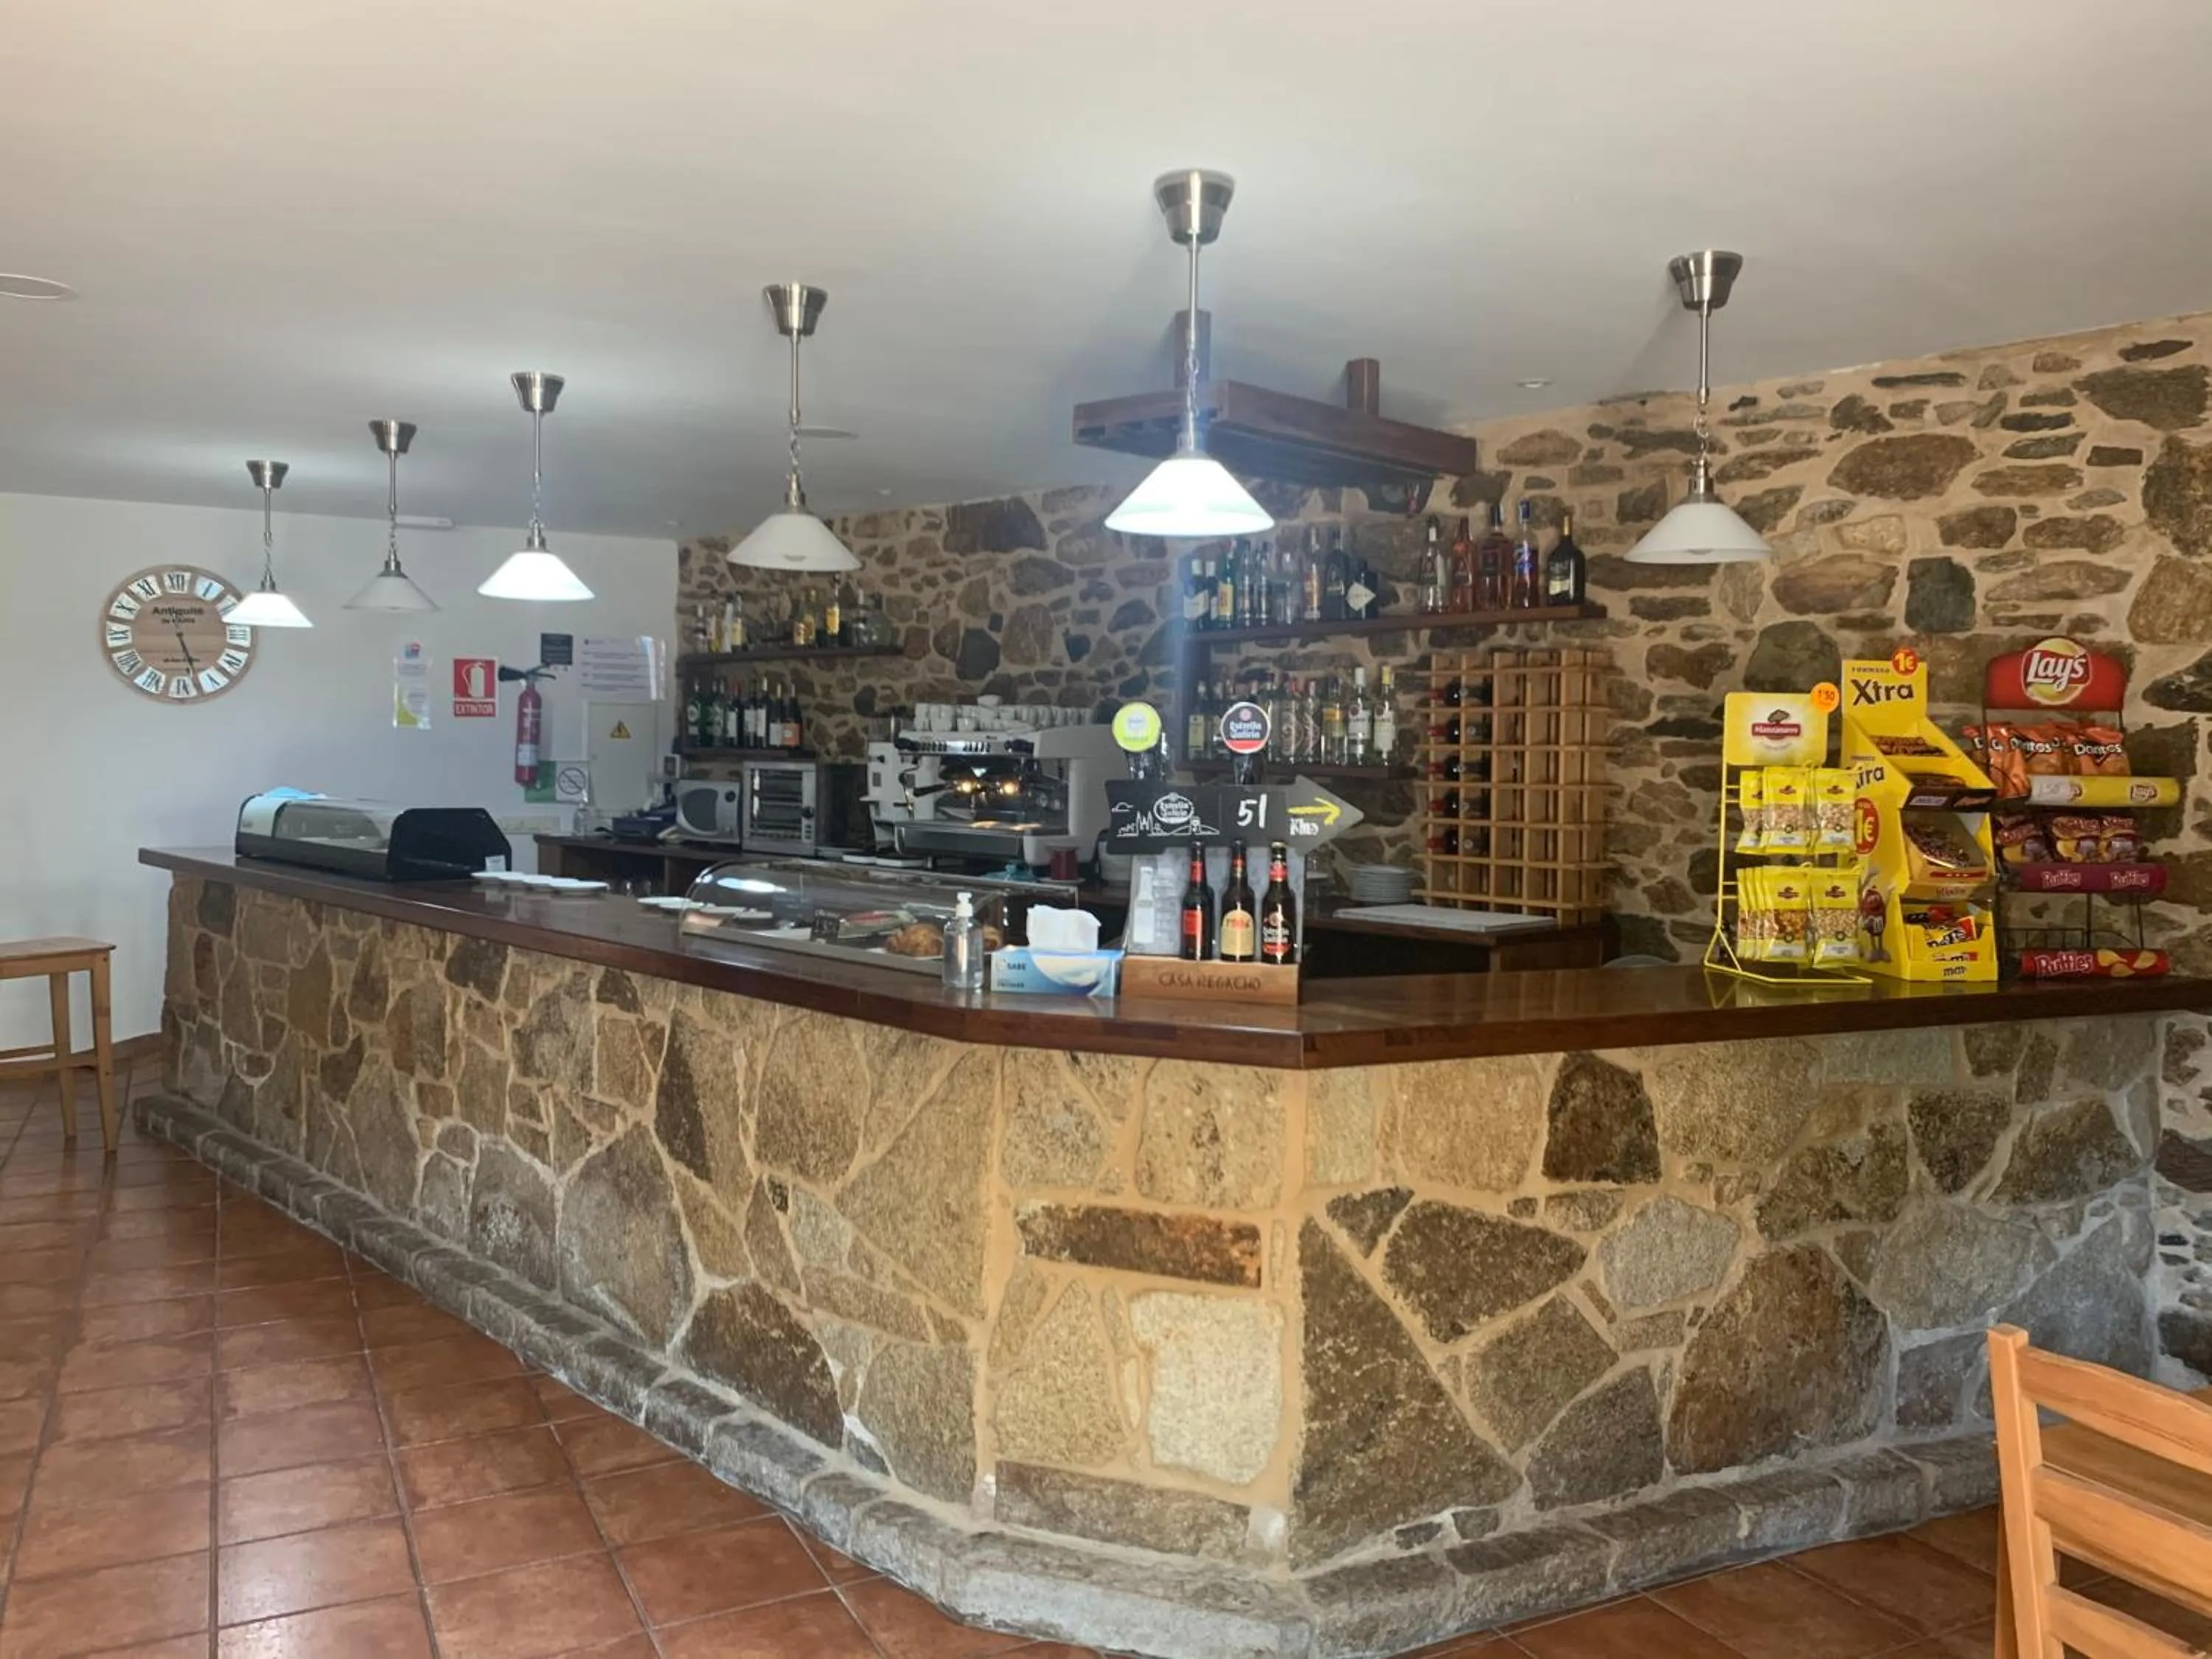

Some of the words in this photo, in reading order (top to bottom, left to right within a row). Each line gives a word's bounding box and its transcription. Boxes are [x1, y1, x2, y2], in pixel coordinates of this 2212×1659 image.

[1893, 653, 1915, 672] 1€
[1851, 678, 1914, 706] Xtra
[455, 703, 494, 714] EXTINTOR
[1229, 720, 1262, 731] Estrella
[2073, 742, 2123, 755] Doritos
[1852, 766, 1885, 789] tra
[1237, 793, 1267, 829] 51
[2035, 950, 2093, 976] Ruffles
